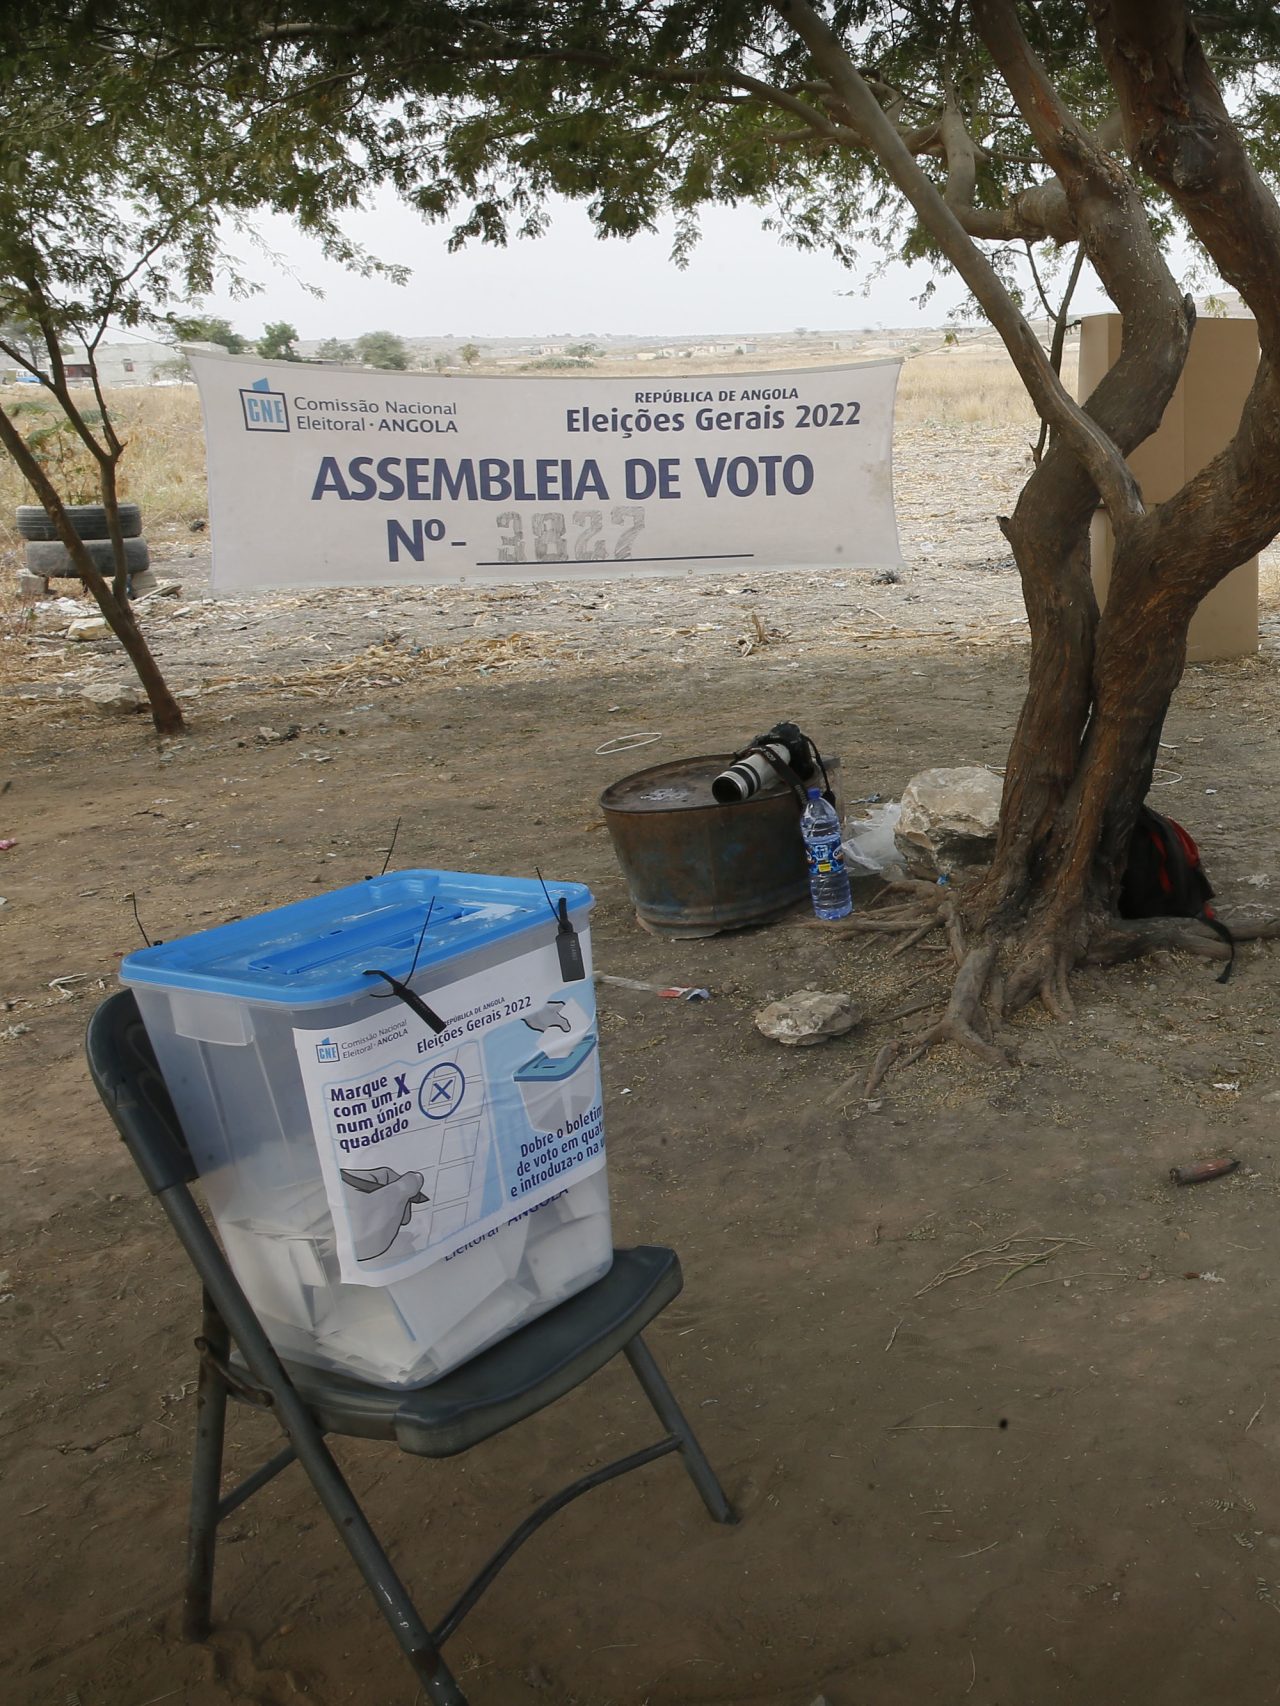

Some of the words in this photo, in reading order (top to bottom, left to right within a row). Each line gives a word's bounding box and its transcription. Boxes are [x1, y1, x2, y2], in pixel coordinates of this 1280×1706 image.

[247, 397, 285, 424] CNE
[294, 397, 380, 413] Comissão
[386, 401, 457, 415] Nacional
[635, 389, 714, 403] REPÚBLICA
[718, 390, 736, 402] DE
[740, 388, 799, 400] ANGOLA
[297, 416, 365, 431] Eleitoral
[378, 419, 458, 432] ANGOLA
[566, 406, 685, 438] Eleições
[695, 404, 785, 431] Gerais
[795, 401, 861, 428] 2022
[311, 456, 610, 501] ASSEMBLEIA
[625, 458, 681, 500] DE
[695, 454, 814, 498] VOTO
[417, 1027, 463, 1054] Eleições
[466, 1008, 502, 1032] Gerais
[504, 996, 532, 1017] 2022
[444, 1007, 473, 1026] EPÚBLICA
[474, 1006, 482, 1015] DE
[483, 997, 505, 1012] ANGOLA
[341, 1030, 377, 1050] Comissão
[379, 1019, 407, 1039] Nacional
[342, 1041, 373, 1059] Eleitoral
[377, 1029, 408, 1047] ANGOLA
[319, 1047, 338, 1061] CNE
[330, 1076, 388, 1101] Marque
[333, 1102, 367, 1117] com
[371, 1092, 392, 1109] um
[394, 1073, 410, 1098] X
[336, 1117, 373, 1134] num
[377, 1100, 411, 1124] único
[339, 1118, 408, 1153] quadrado
[520, 1133, 554, 1157] Dobre
[556, 1128, 563, 1139] o
[510, 1186, 518, 1197] e
[520, 1154, 584, 1193] introduza-o
[586, 1143, 599, 1158] na
[517, 1161, 531, 1176] de
[533, 1148, 559, 1167] voto
[561, 1138, 578, 1153] em
